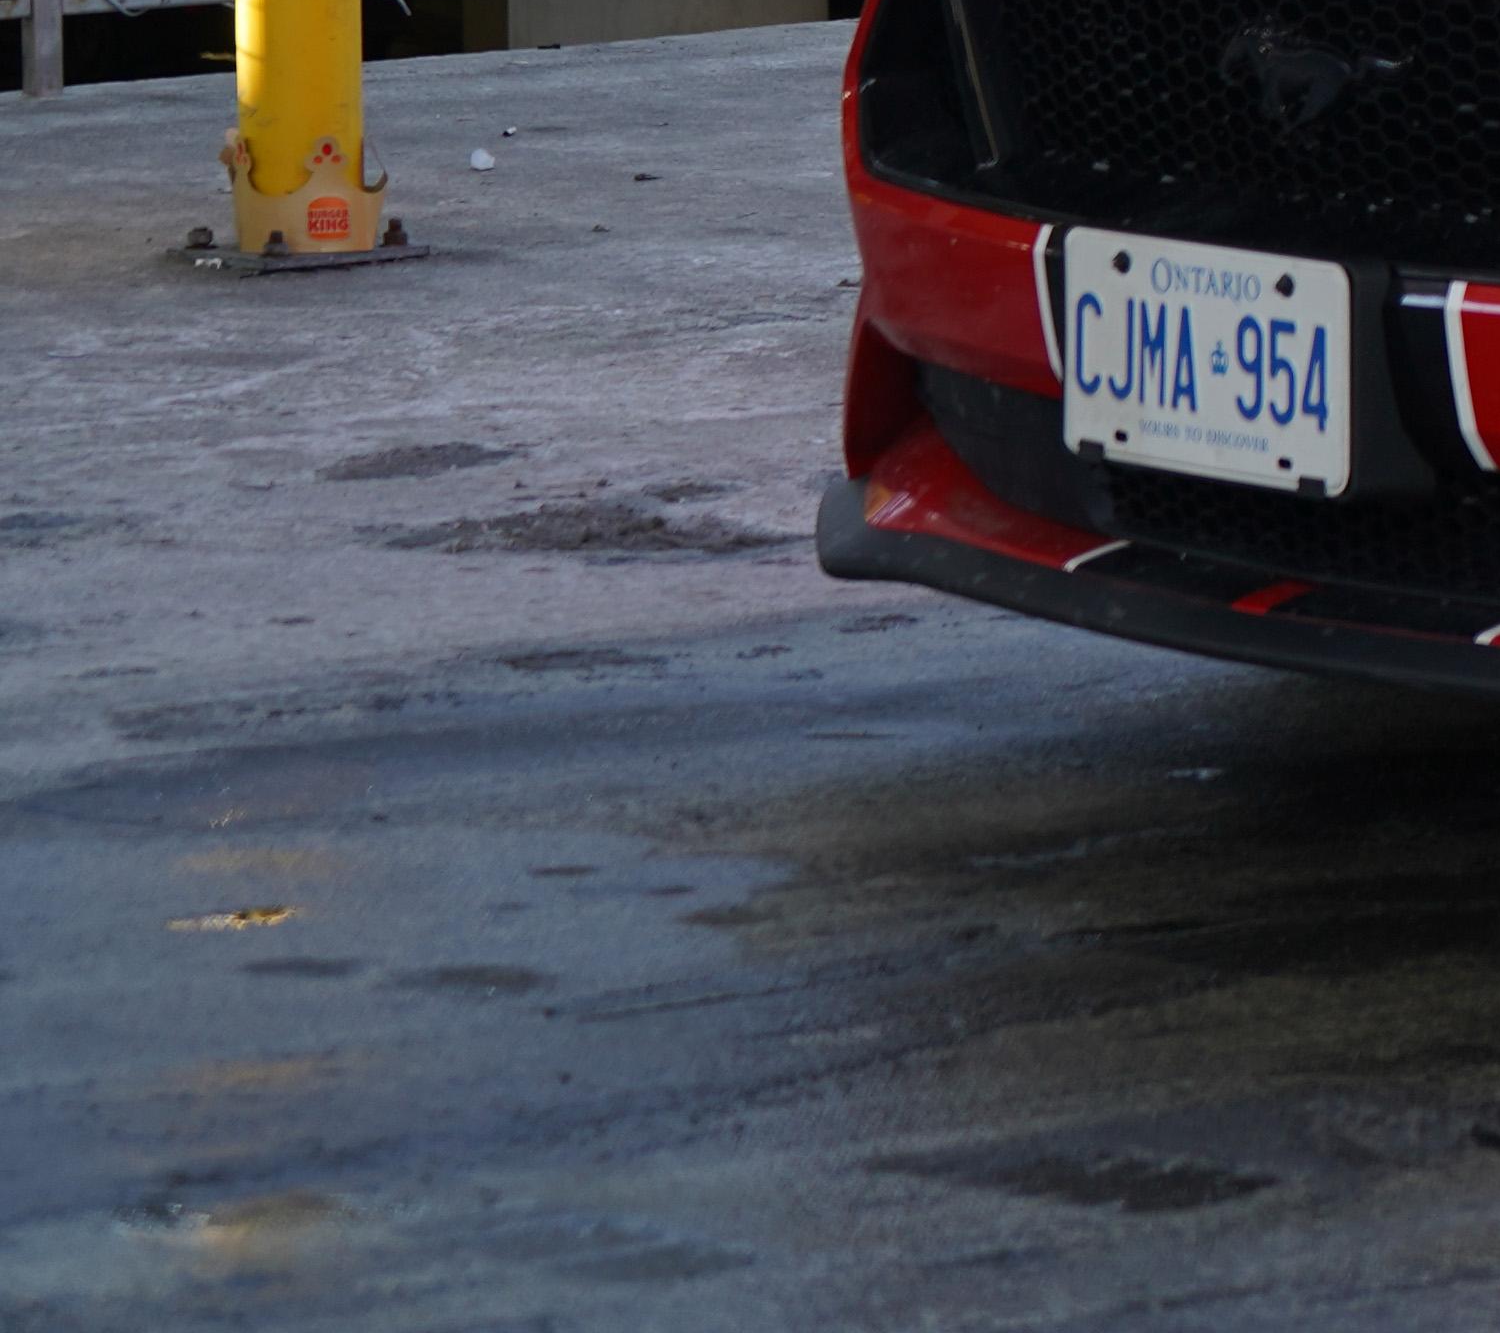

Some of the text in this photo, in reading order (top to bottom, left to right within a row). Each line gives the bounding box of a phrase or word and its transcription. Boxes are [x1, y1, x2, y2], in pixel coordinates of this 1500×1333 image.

[308, 218, 349, 233] KING
[1151, 257, 1261, 303] ONTARIO
[1076, 292, 1327, 434] CJMA 954
[1184, 426, 1202, 442] TO
[1205, 429, 1270, 451] DISCOVER
